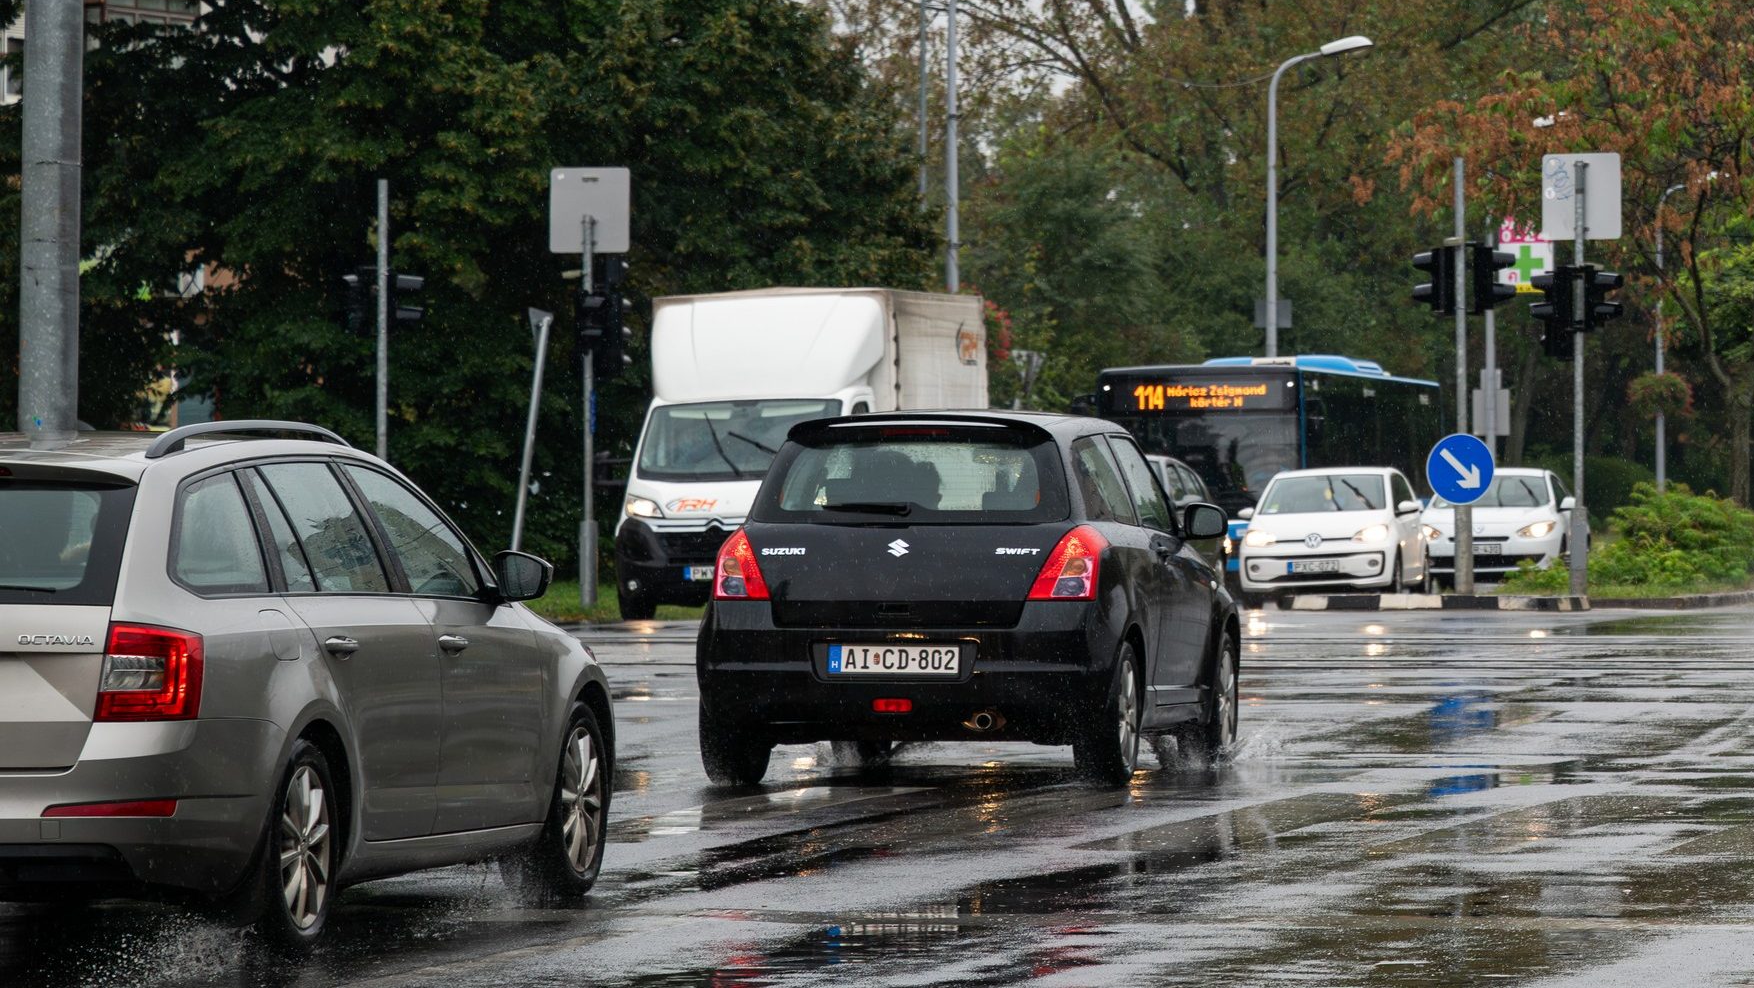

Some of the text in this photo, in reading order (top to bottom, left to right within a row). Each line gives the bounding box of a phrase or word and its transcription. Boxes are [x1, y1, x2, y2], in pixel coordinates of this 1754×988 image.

[1134, 384, 1267, 410] 114 Móricz Zsigmond
[761, 547, 806, 556] SUZUKI
[995, 547, 1040, 556] SWIFT
[17, 634, 95, 646] OCTAVIA
[844, 648, 870, 669] AI
[882, 649, 956, 670] CD-802
